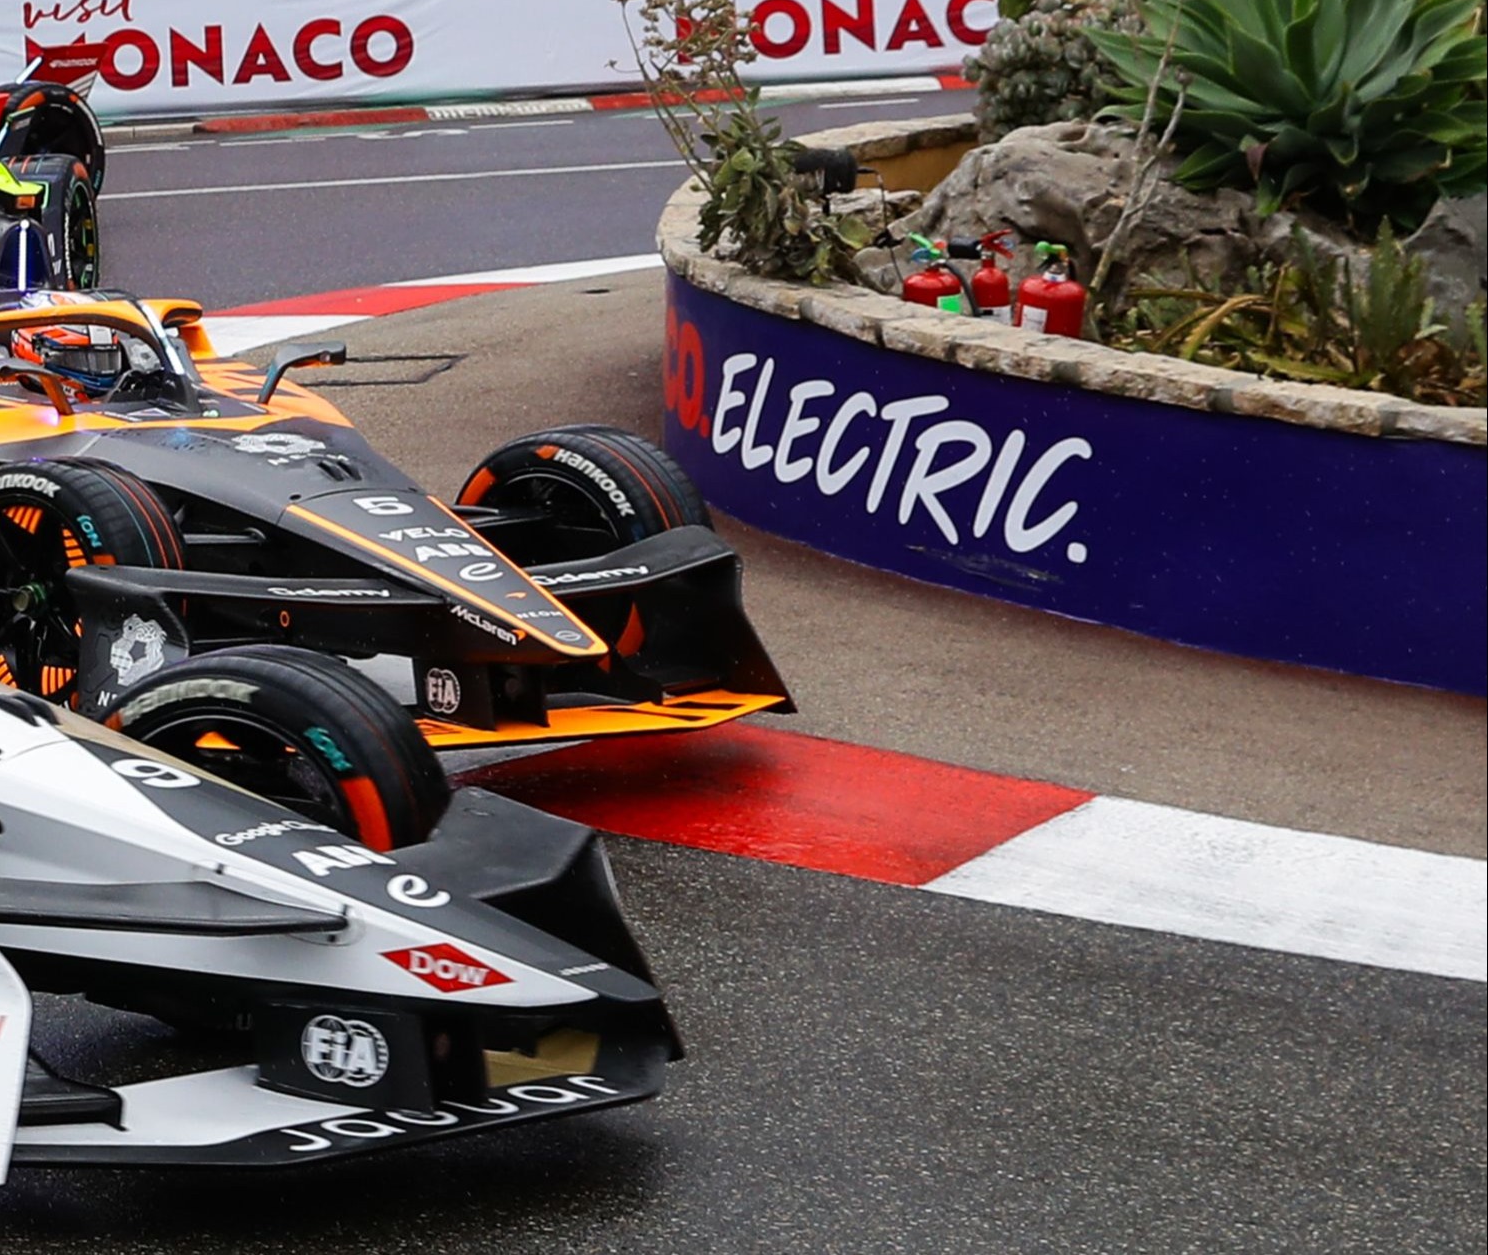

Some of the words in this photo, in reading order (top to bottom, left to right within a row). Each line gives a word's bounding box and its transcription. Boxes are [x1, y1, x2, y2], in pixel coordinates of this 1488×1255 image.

[711, 352, 1093, 564] ELECTRIC.
[554, 446, 636, 518] Hankook
[352, 495, 415, 516] 5
[378, 526, 471, 542] VELO
[414, 543, 494, 563] ABB
[528, 564, 650, 586] Udemy
[450, 604, 518, 646] McLaren
[515, 609, 565, 619] NEOM
[111, 758, 202, 789] 9
[215, 821, 288, 847] Google
[408, 950, 491, 986] Dow
[306, 1025, 376, 1075] FIA
